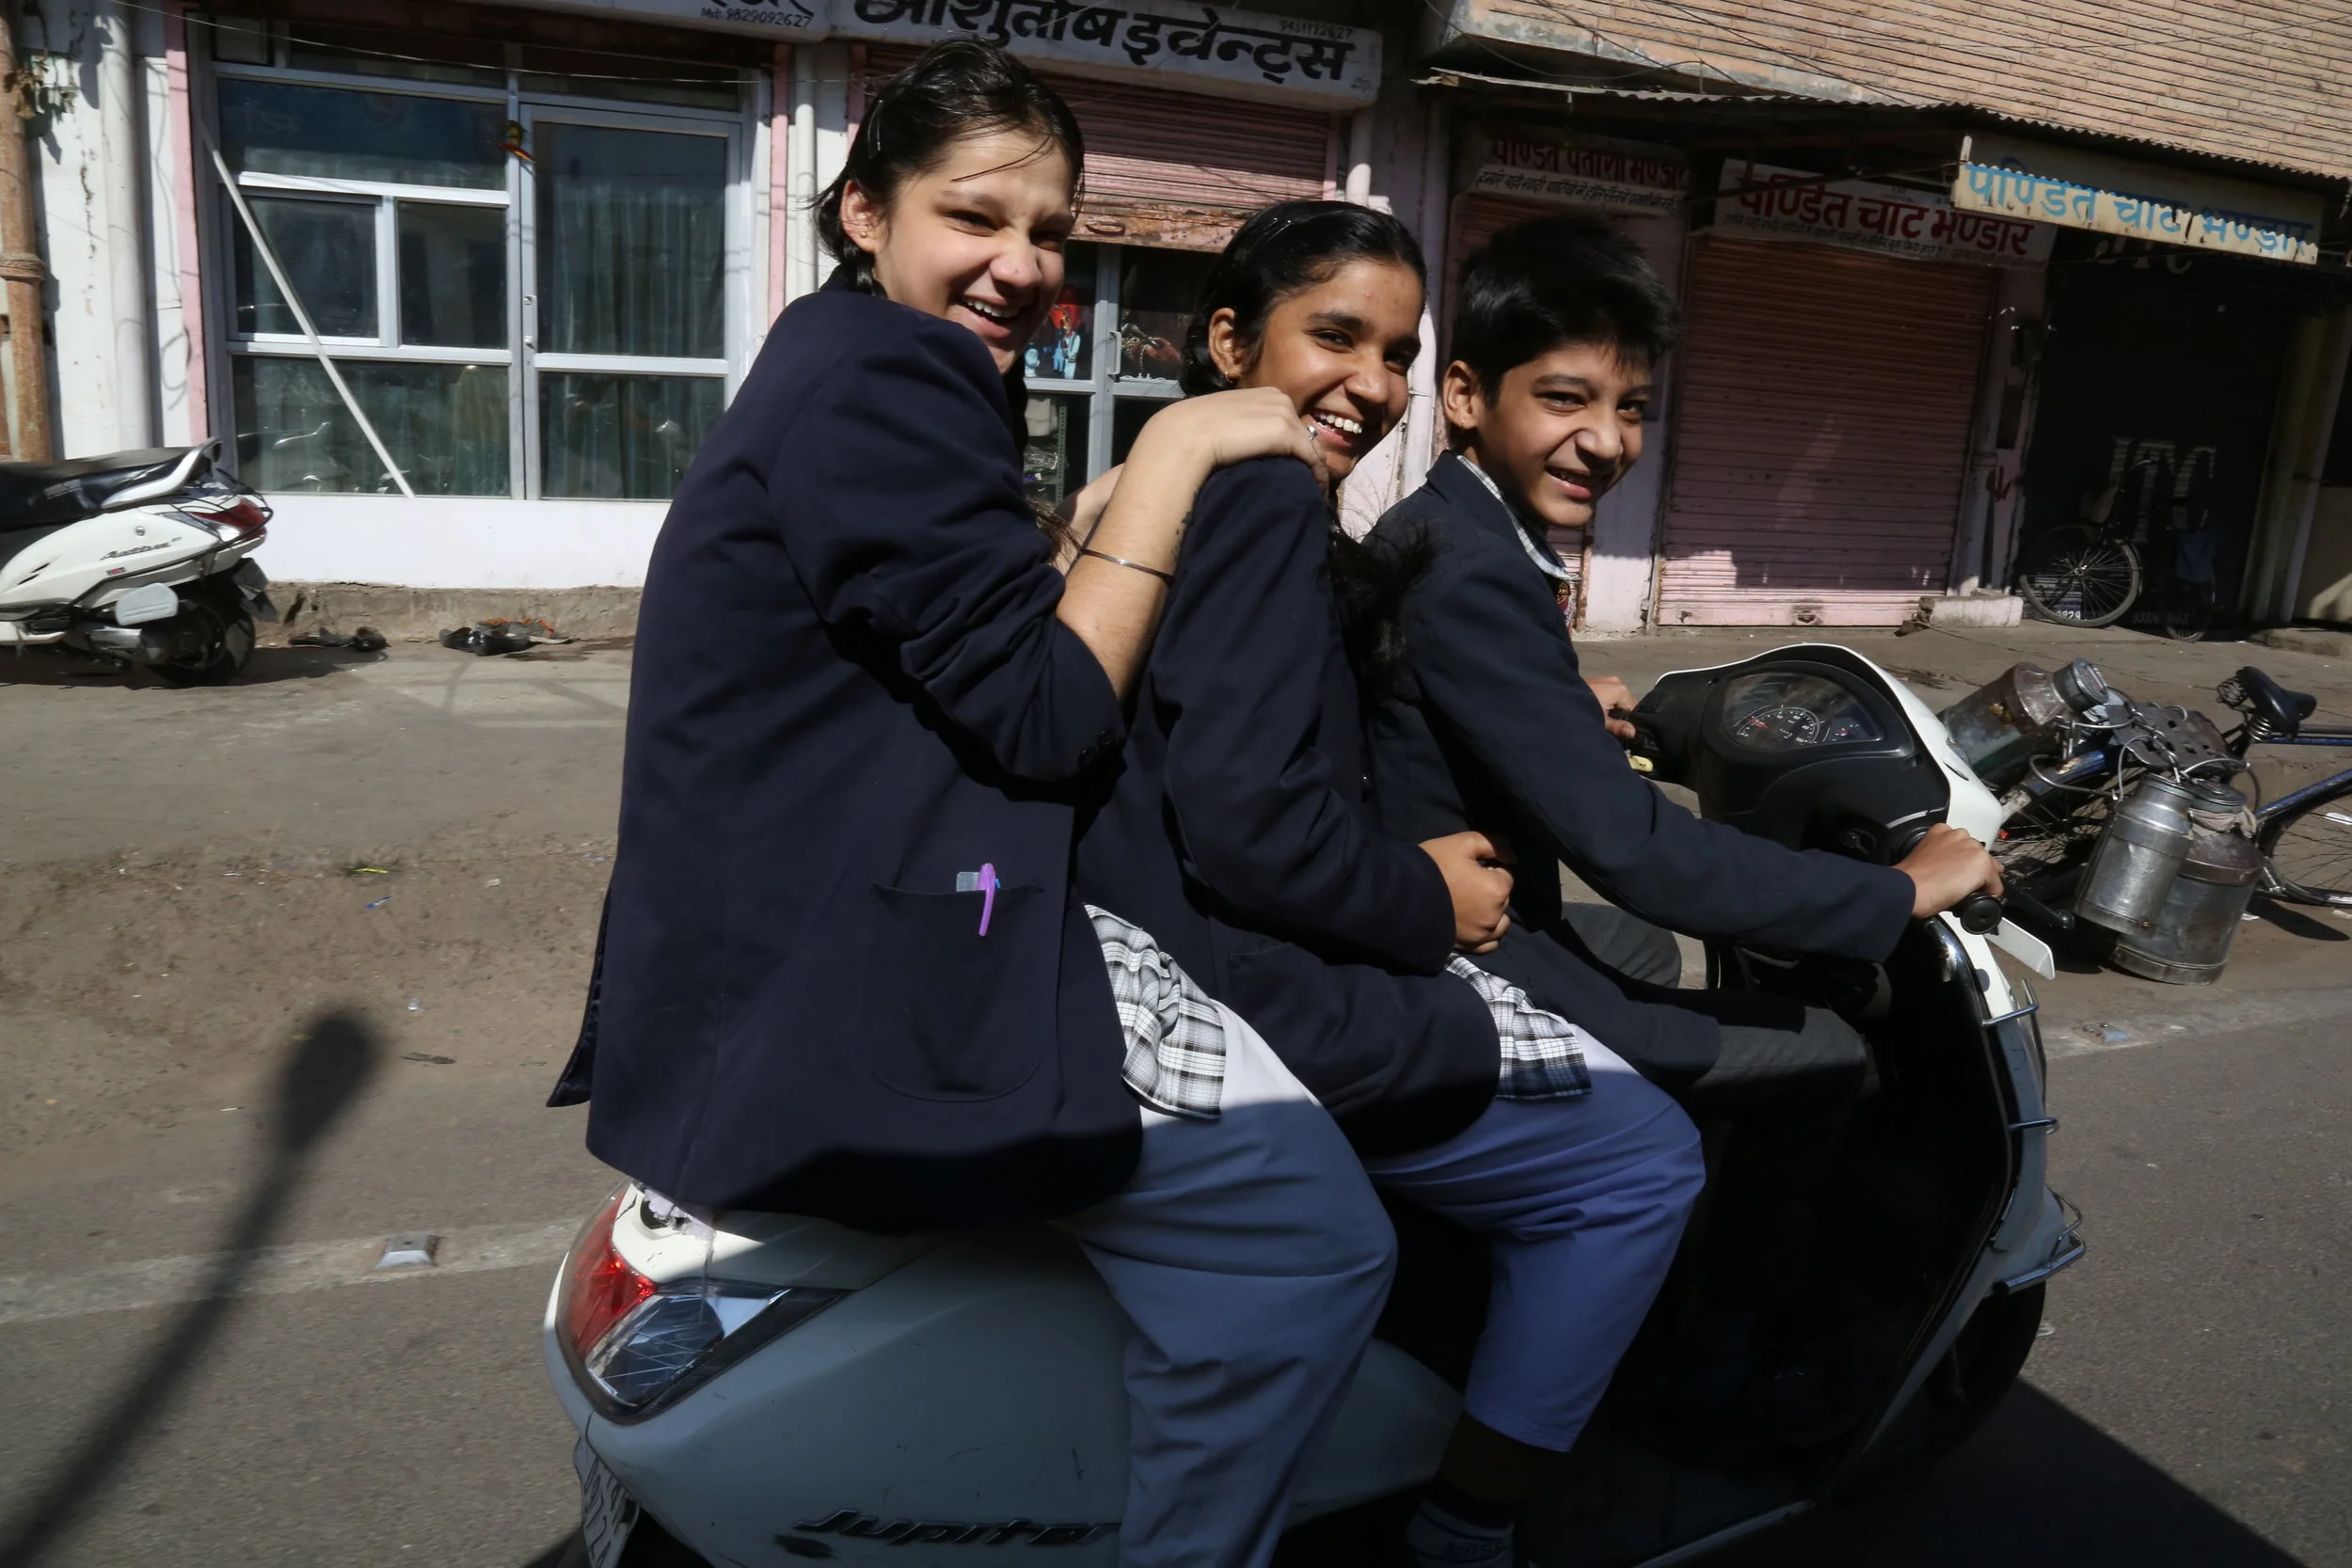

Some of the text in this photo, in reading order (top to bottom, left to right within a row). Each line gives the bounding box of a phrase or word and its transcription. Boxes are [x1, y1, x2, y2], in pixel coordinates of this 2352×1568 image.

[725, 8, 813, 28] 9829092627
[1856, 197, 1929, 239] चाट
[1931, 209, 2035, 256] भण्डार
[791, 1506, 1121, 1546] Jupiter
